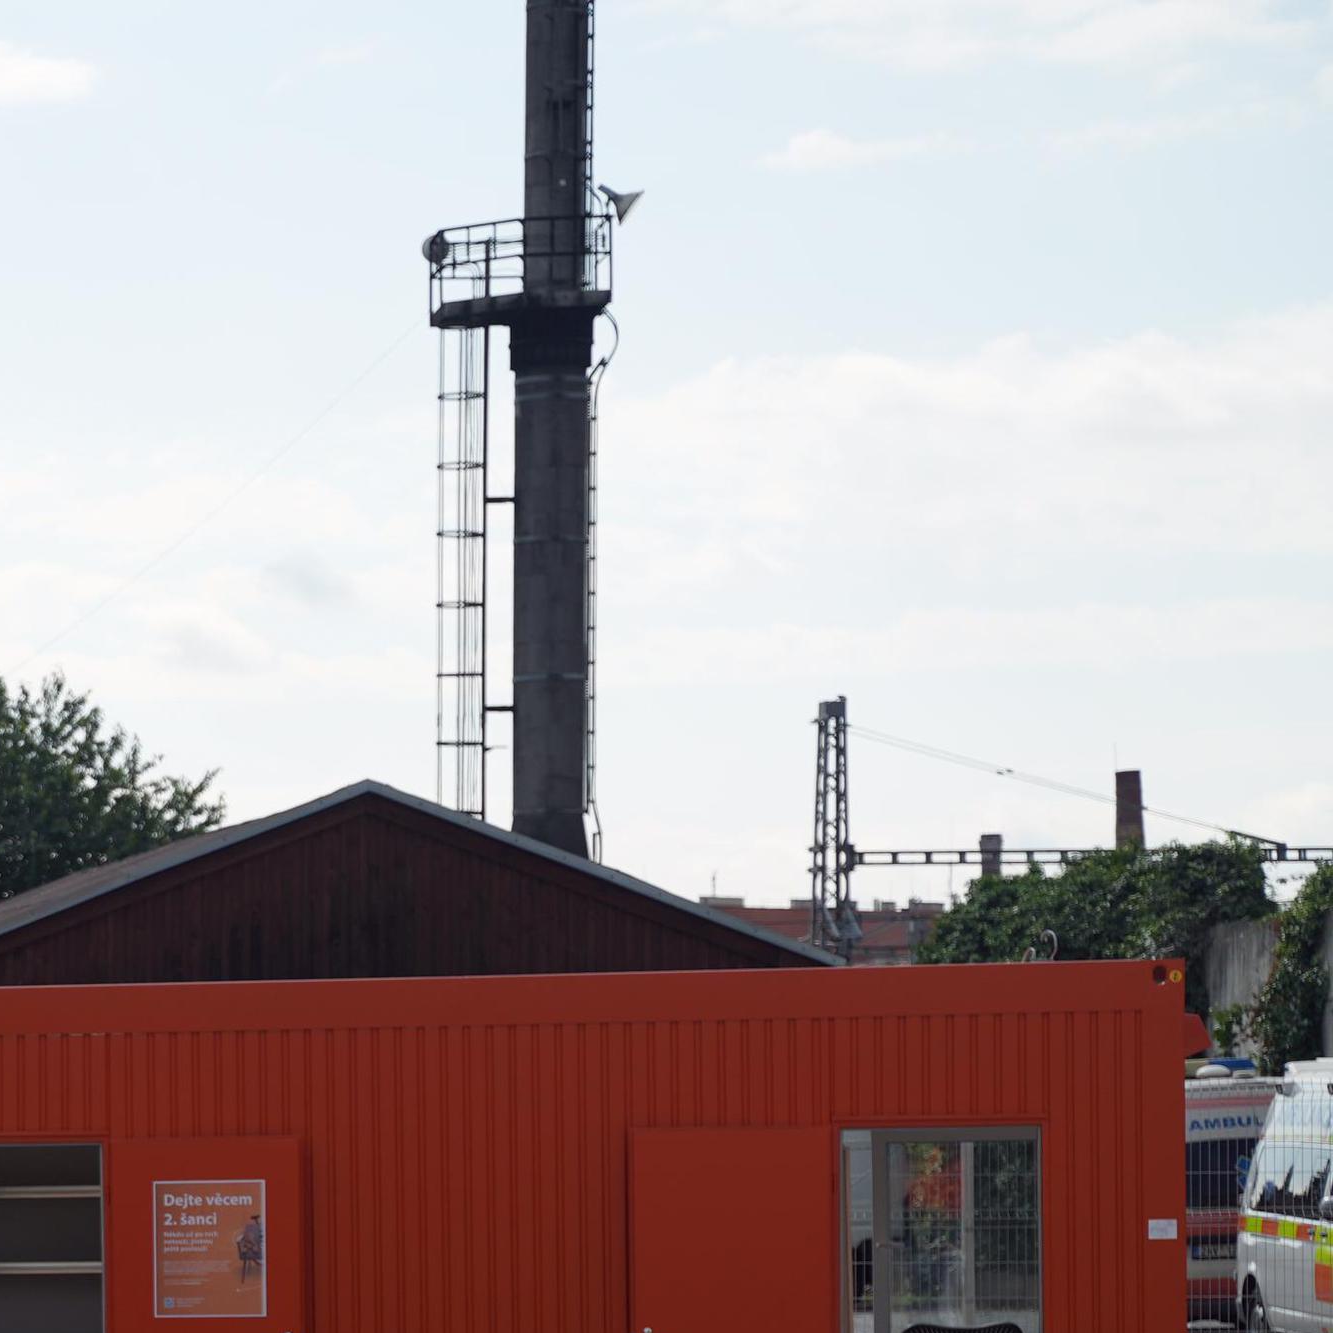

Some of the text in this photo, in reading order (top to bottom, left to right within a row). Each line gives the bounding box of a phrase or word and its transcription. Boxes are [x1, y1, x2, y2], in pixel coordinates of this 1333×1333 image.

[163, 1193, 253, 1209] Dejte věcem
[164, 1212, 217, 1226] 2. šanci
